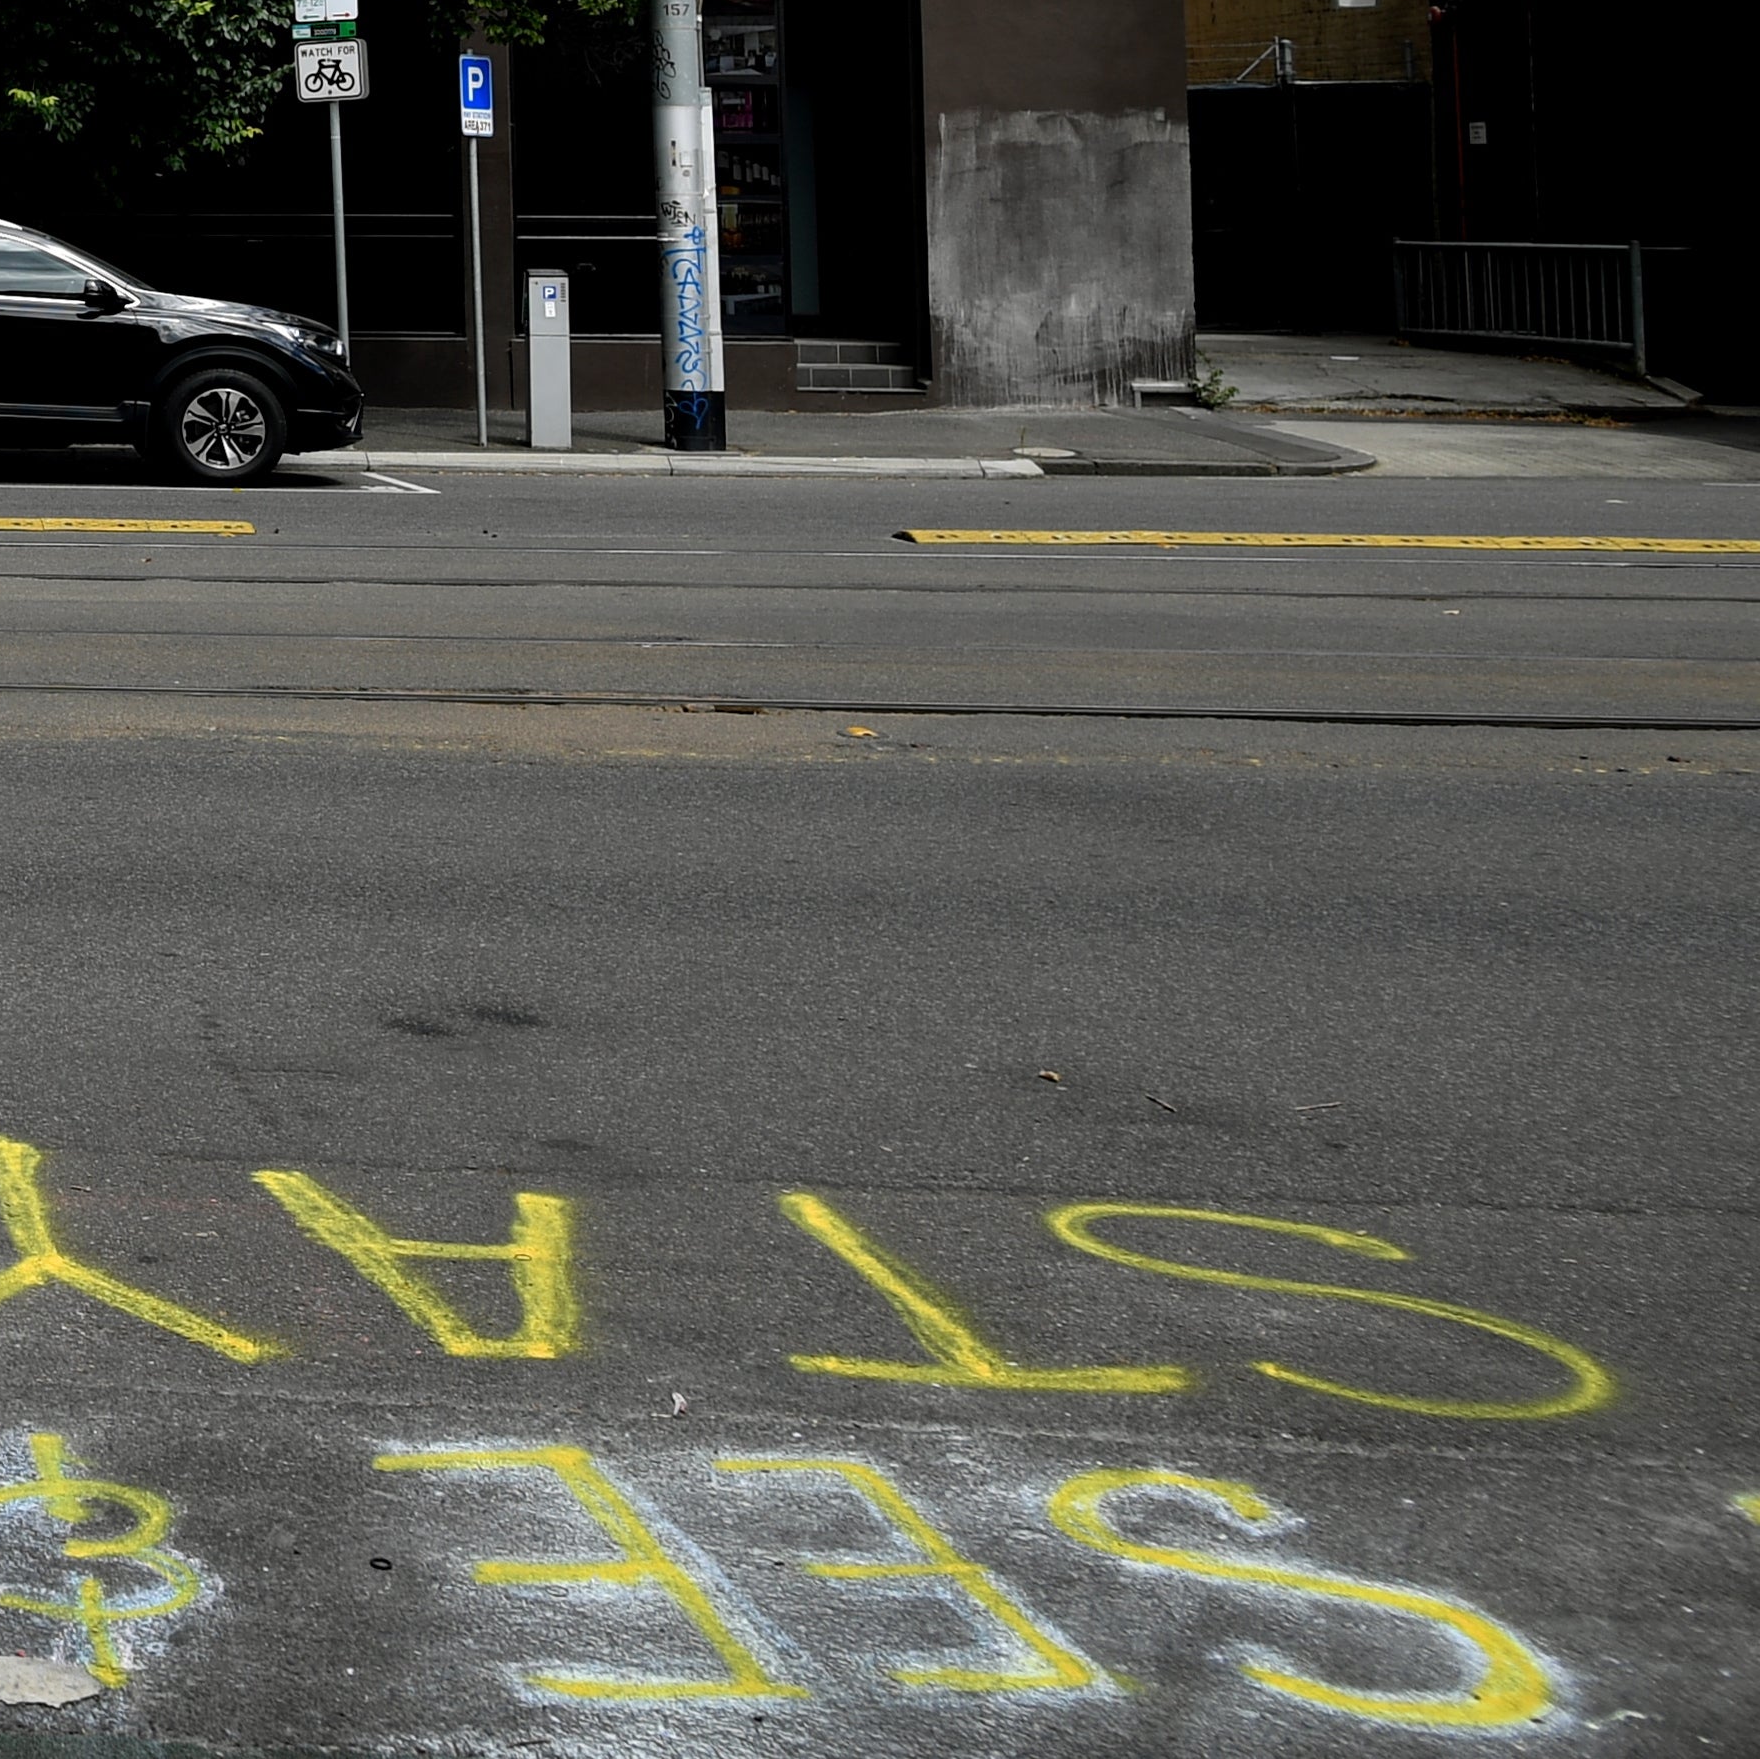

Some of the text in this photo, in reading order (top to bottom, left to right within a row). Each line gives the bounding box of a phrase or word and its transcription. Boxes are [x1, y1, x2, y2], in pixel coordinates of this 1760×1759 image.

[663, 3, 690, 16] 157
[301, 45, 355, 57] WATCH FOR
[468, 66, 483, 101] P
[373, 1445, 1554, 1729] SEE
